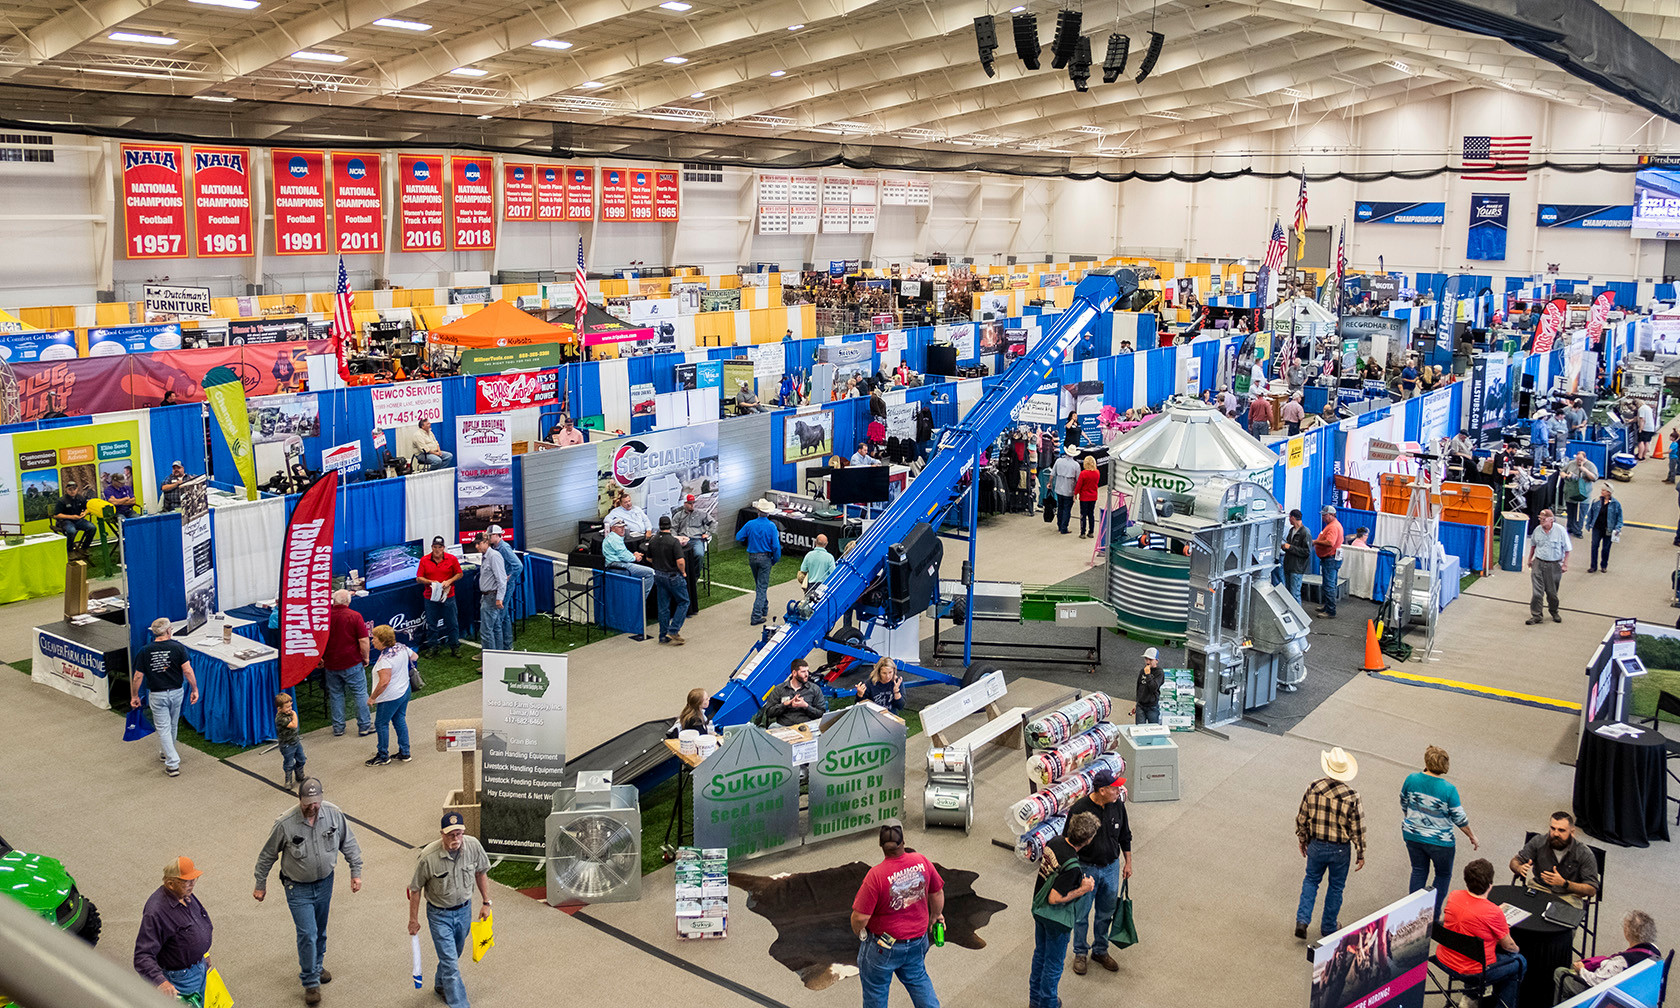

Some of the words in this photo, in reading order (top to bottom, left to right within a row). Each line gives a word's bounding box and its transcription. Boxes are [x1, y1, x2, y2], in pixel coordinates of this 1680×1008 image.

[124, 150, 177, 173] NAIA
[194, 153, 244, 175] NAIA
[131, 183, 177, 195] NATIONAL
[201, 185, 244, 195] NATIONAL
[280, 186, 319, 196] NATIONAL
[339, 187, 376, 196] NATIONAL
[406, 185, 438, 193] NATIONAL
[127, 196, 182, 207] CHAMPIONS
[197, 198, 249, 208] CHAMPIONS
[276, 198, 324, 208] CHAMPIONS
[336, 199, 380, 208] CHAMPIONS
[403, 195, 442, 203] CHAMPIONS
[455, 195, 491, 203] CHAMPIONS
[508, 206, 531, 217] 2017
[540, 206, 562, 217] 2017
[569, 206, 591, 217] 2016
[605, 207, 625, 217] 1999
[632, 207, 651, 217] 1995
[657, 207, 676, 217] 1965
[1476, 206, 1502, 217] YOURS
[139, 215, 173, 224] Football
[208, 216, 240, 224] Football
[287, 215, 315, 224] Football
[346, 215, 372, 223] Football
[1394, 215, 1443, 223] CHAMPIONSHIPS
[204, 234, 247, 252] 1961
[283, 233, 322, 250] 1991
[341, 233, 378, 249] 2011
[407, 231, 441, 247] 2016
[458, 230, 490, 245] 2018
[133, 235, 181, 253] 1957
[164, 289, 207, 300] Dutchman's
[146, 300, 209, 313] FURNITURE
[1439, 287, 1454, 333] Leader
[1436, 334, 1447, 350] Ag
[372, 388, 405, 401] NEWCO
[405, 384, 442, 397] SERVICE
[534, 392, 555, 401] MOWER
[1471, 379, 1482, 430] MLSTUBS.COM
[214, 391, 239, 437] Channel
[377, 407, 440, 425] 417-451-2660
[462, 420, 480, 434] JOPLIN
[481, 419, 506, 432] REGIONAL
[20, 451, 56, 461] Customized
[103, 449, 127, 457] Products
[617, 443, 702, 475] SPECIALTY
[480, 468, 509, 476] PARTNER
[1130, 466, 1187, 493] Sukup
[287, 518, 325, 599] REGIONAL
[311, 545, 332, 632] STOCKYARDS
[285, 603, 320, 658] JOPLIN
[40, 636, 64, 656] CLEAVER
[64, 645, 80, 663] FARM
[80, 655, 86, 665] &
[86, 653, 106, 673] HOME
[503, 700, 514, 708] and
[514, 701, 529, 709] Farm
[530, 702, 551, 711] Supply,
[509, 709, 529, 717] Lamar,
[525, 738, 537, 746] Bins
[489, 749, 504, 757] Grain
[504, 750, 528, 760] Handling
[529, 752, 558, 761] Equipment
[825, 748, 891, 772] Sukup
[484, 762, 509, 770] Livestock
[509, 764, 534, 774] Handling
[534, 765, 564, 775] Equipment
[484, 775, 510, 784] Livestock
[510, 777, 532, 787] Feeding
[533, 779, 562, 788] Equipment
[711, 770, 784, 797] Sukup
[826, 779, 862, 798] Built
[866, 774, 884, 788] By
[487, 789, 498, 797] Hay
[498, 790, 527, 799] Equipment
[811, 794, 874, 819] Midwest
[879, 787, 902, 803] Bin
[711, 802, 750, 824] Seed
[755, 796, 784, 814] and
[813, 814, 875, 837] Builders,
[878, 805, 899, 821] Inc
[487, 838, 546, 849] www.seedandfarm.c
